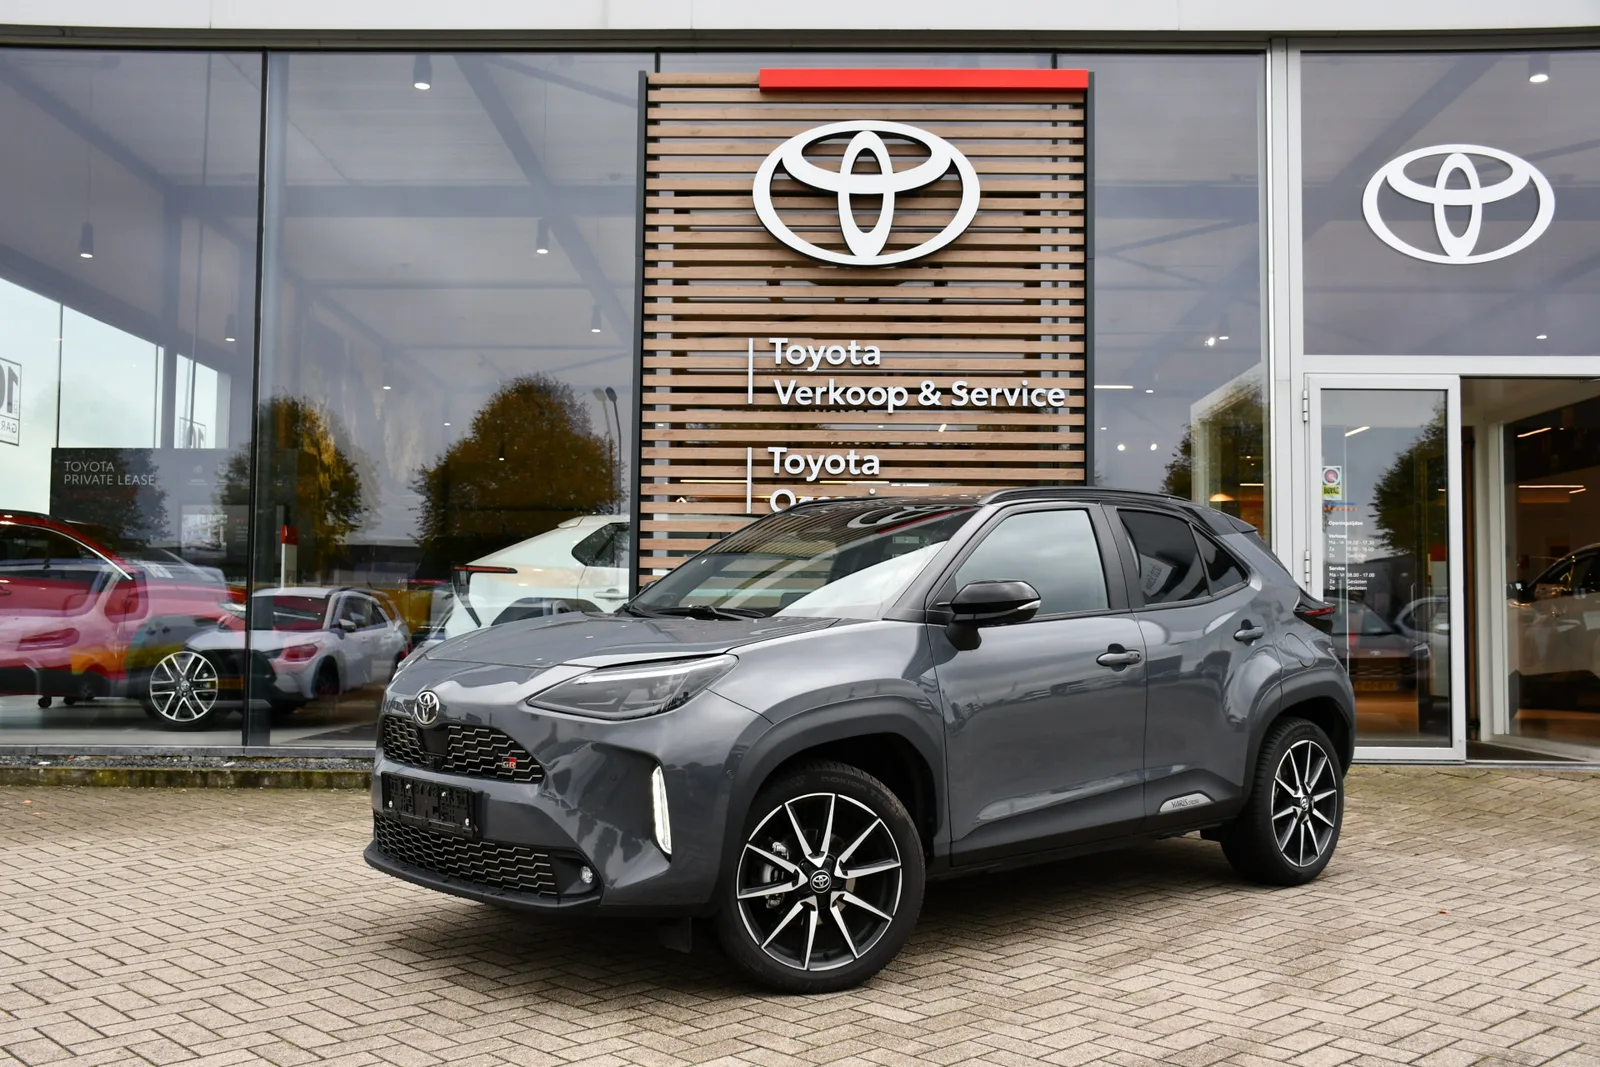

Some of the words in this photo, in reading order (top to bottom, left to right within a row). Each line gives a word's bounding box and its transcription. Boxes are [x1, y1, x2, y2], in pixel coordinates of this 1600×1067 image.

[769, 338, 881, 371] Toyota
[774, 378, 908, 414] Verkoop
[918, 380, 942, 406] &
[951, 380, 1065, 407] Service
[64, 461, 115, 472] TOYOTA
[64, 474, 114, 485] PRIVATE
[117, 474, 156, 486] LEASE
[768, 447, 880, 481] Toyota
